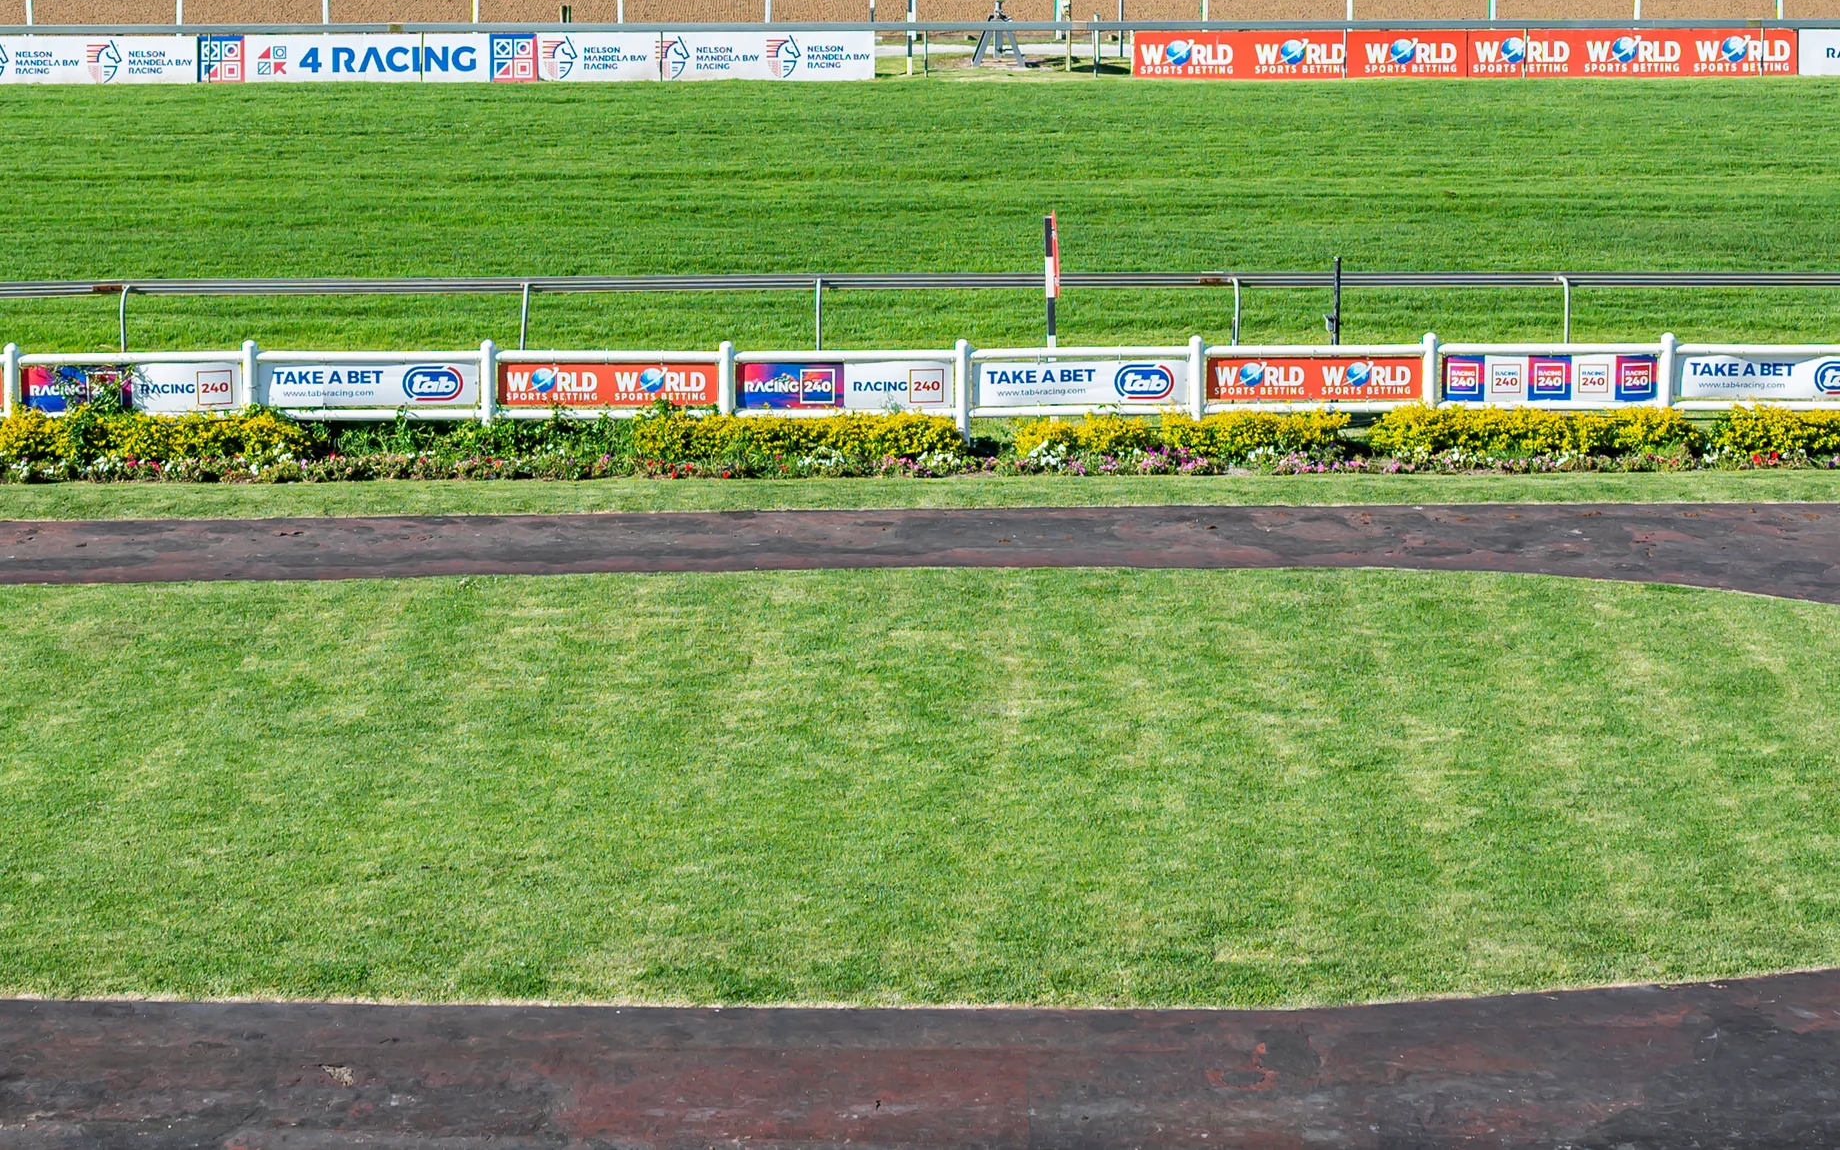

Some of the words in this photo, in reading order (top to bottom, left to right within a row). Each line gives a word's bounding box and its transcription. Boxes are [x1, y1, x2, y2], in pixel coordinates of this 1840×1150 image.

[15, 50, 53, 58] NELSON
[128, 50, 166, 58] NELSON
[1140, 39, 1234, 65] WORLD
[1255, 38, 1347, 65] WORLD
[1365, 38, 1457, 64] WORLD
[1475, 36, 1570, 64] WORLD
[1586, 35, 1681, 63] WORLD
[1695, 35, 1790, 63] WORLD
[299, 46, 322, 73] 4
[332, 46, 477, 73] RACING
[15, 67, 50, 75] RACING
[1140, 65, 1182, 75] SPORTS
[1187, 65, 1234, 75] BETTING
[1255, 65, 1297, 74] SPORTS
[1365, 64, 1406, 73] SPORTS
[1412, 64, 1457, 73] BETTING
[1473, 63, 1516, 73] SPORTS
[1584, 63, 1628, 73] SPORTS
[1632, 62, 1680, 73] BETTING
[1693, 63, 1737, 72] SPORTS
[1215, 361, 1305, 387] WORLD
[1322, 361, 1411, 387] WORLD
[1690, 363, 1738, 376] TAKE
[1743, 363, 1756, 376] A
[1760, 363, 1795, 376] BET
[273, 370, 323, 385] TAKE
[328, 370, 344, 384] A
[347, 370, 384, 384] BET
[507, 367, 598, 392] WORLD
[615, 367, 706, 392] WORLD
[987, 370, 1037, 385] TAKE
[1041, 369, 1056, 383] A
[1060, 368, 1096, 383] BET
[1495, 377, 1518, 386] 240
[1582, 377, 1605, 386] 240
[1625, 376, 1648, 386] 240
[411, 374, 457, 393] tab
[744, 380, 800, 393] RACING
[803, 381, 832, 393] 240
[853, 381, 908, 392] RACING
[914, 380, 940, 391] 240
[1123, 372, 1168, 392] tab
[1451, 377, 1475, 387] 240
[1538, 377, 1562, 387] 240
[1698, 382, 1785, 390] www.tab4racing.com
[140, 383, 195, 394] RACING
[201, 382, 229, 393] 240
[997, 387, 1086, 397] www.tab4racing.com
[1214, 386, 1255, 395] SPORTS
[1260, 386, 1305, 395] BETTING
[1321, 386, 1362, 395] SPORTS
[1366, 386, 1411, 395] BETTING
[283, 389, 374, 398] www.tab4racing.com
[506, 392, 547, 401] SPORTS
[552, 392, 598, 401] BETTING
[614, 392, 656, 401] SPORTS
[661, 392, 706, 401] BETTING
